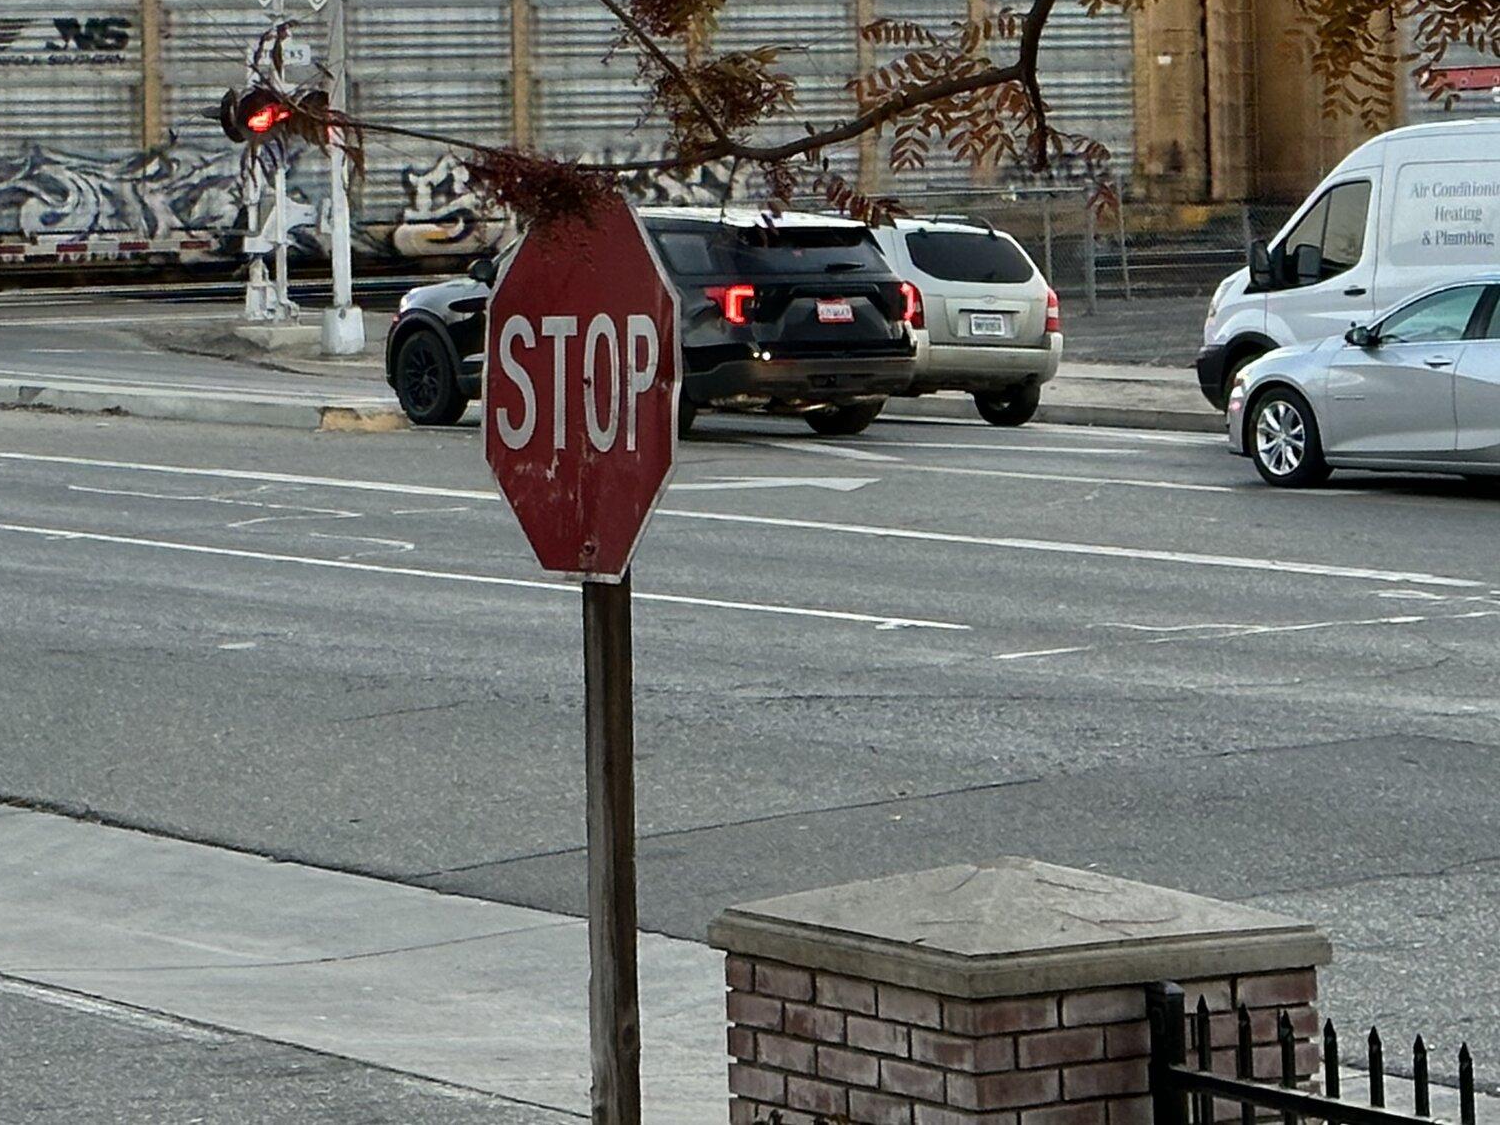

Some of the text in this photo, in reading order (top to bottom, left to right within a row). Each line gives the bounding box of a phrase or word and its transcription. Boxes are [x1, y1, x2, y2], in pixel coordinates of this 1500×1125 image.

[1411, 181, 1500, 199] Air Conditioni
[1434, 205, 1483, 223] Heating
[1421, 229, 1495, 247] & Plumbing
[496, 312, 660, 453] STOP
